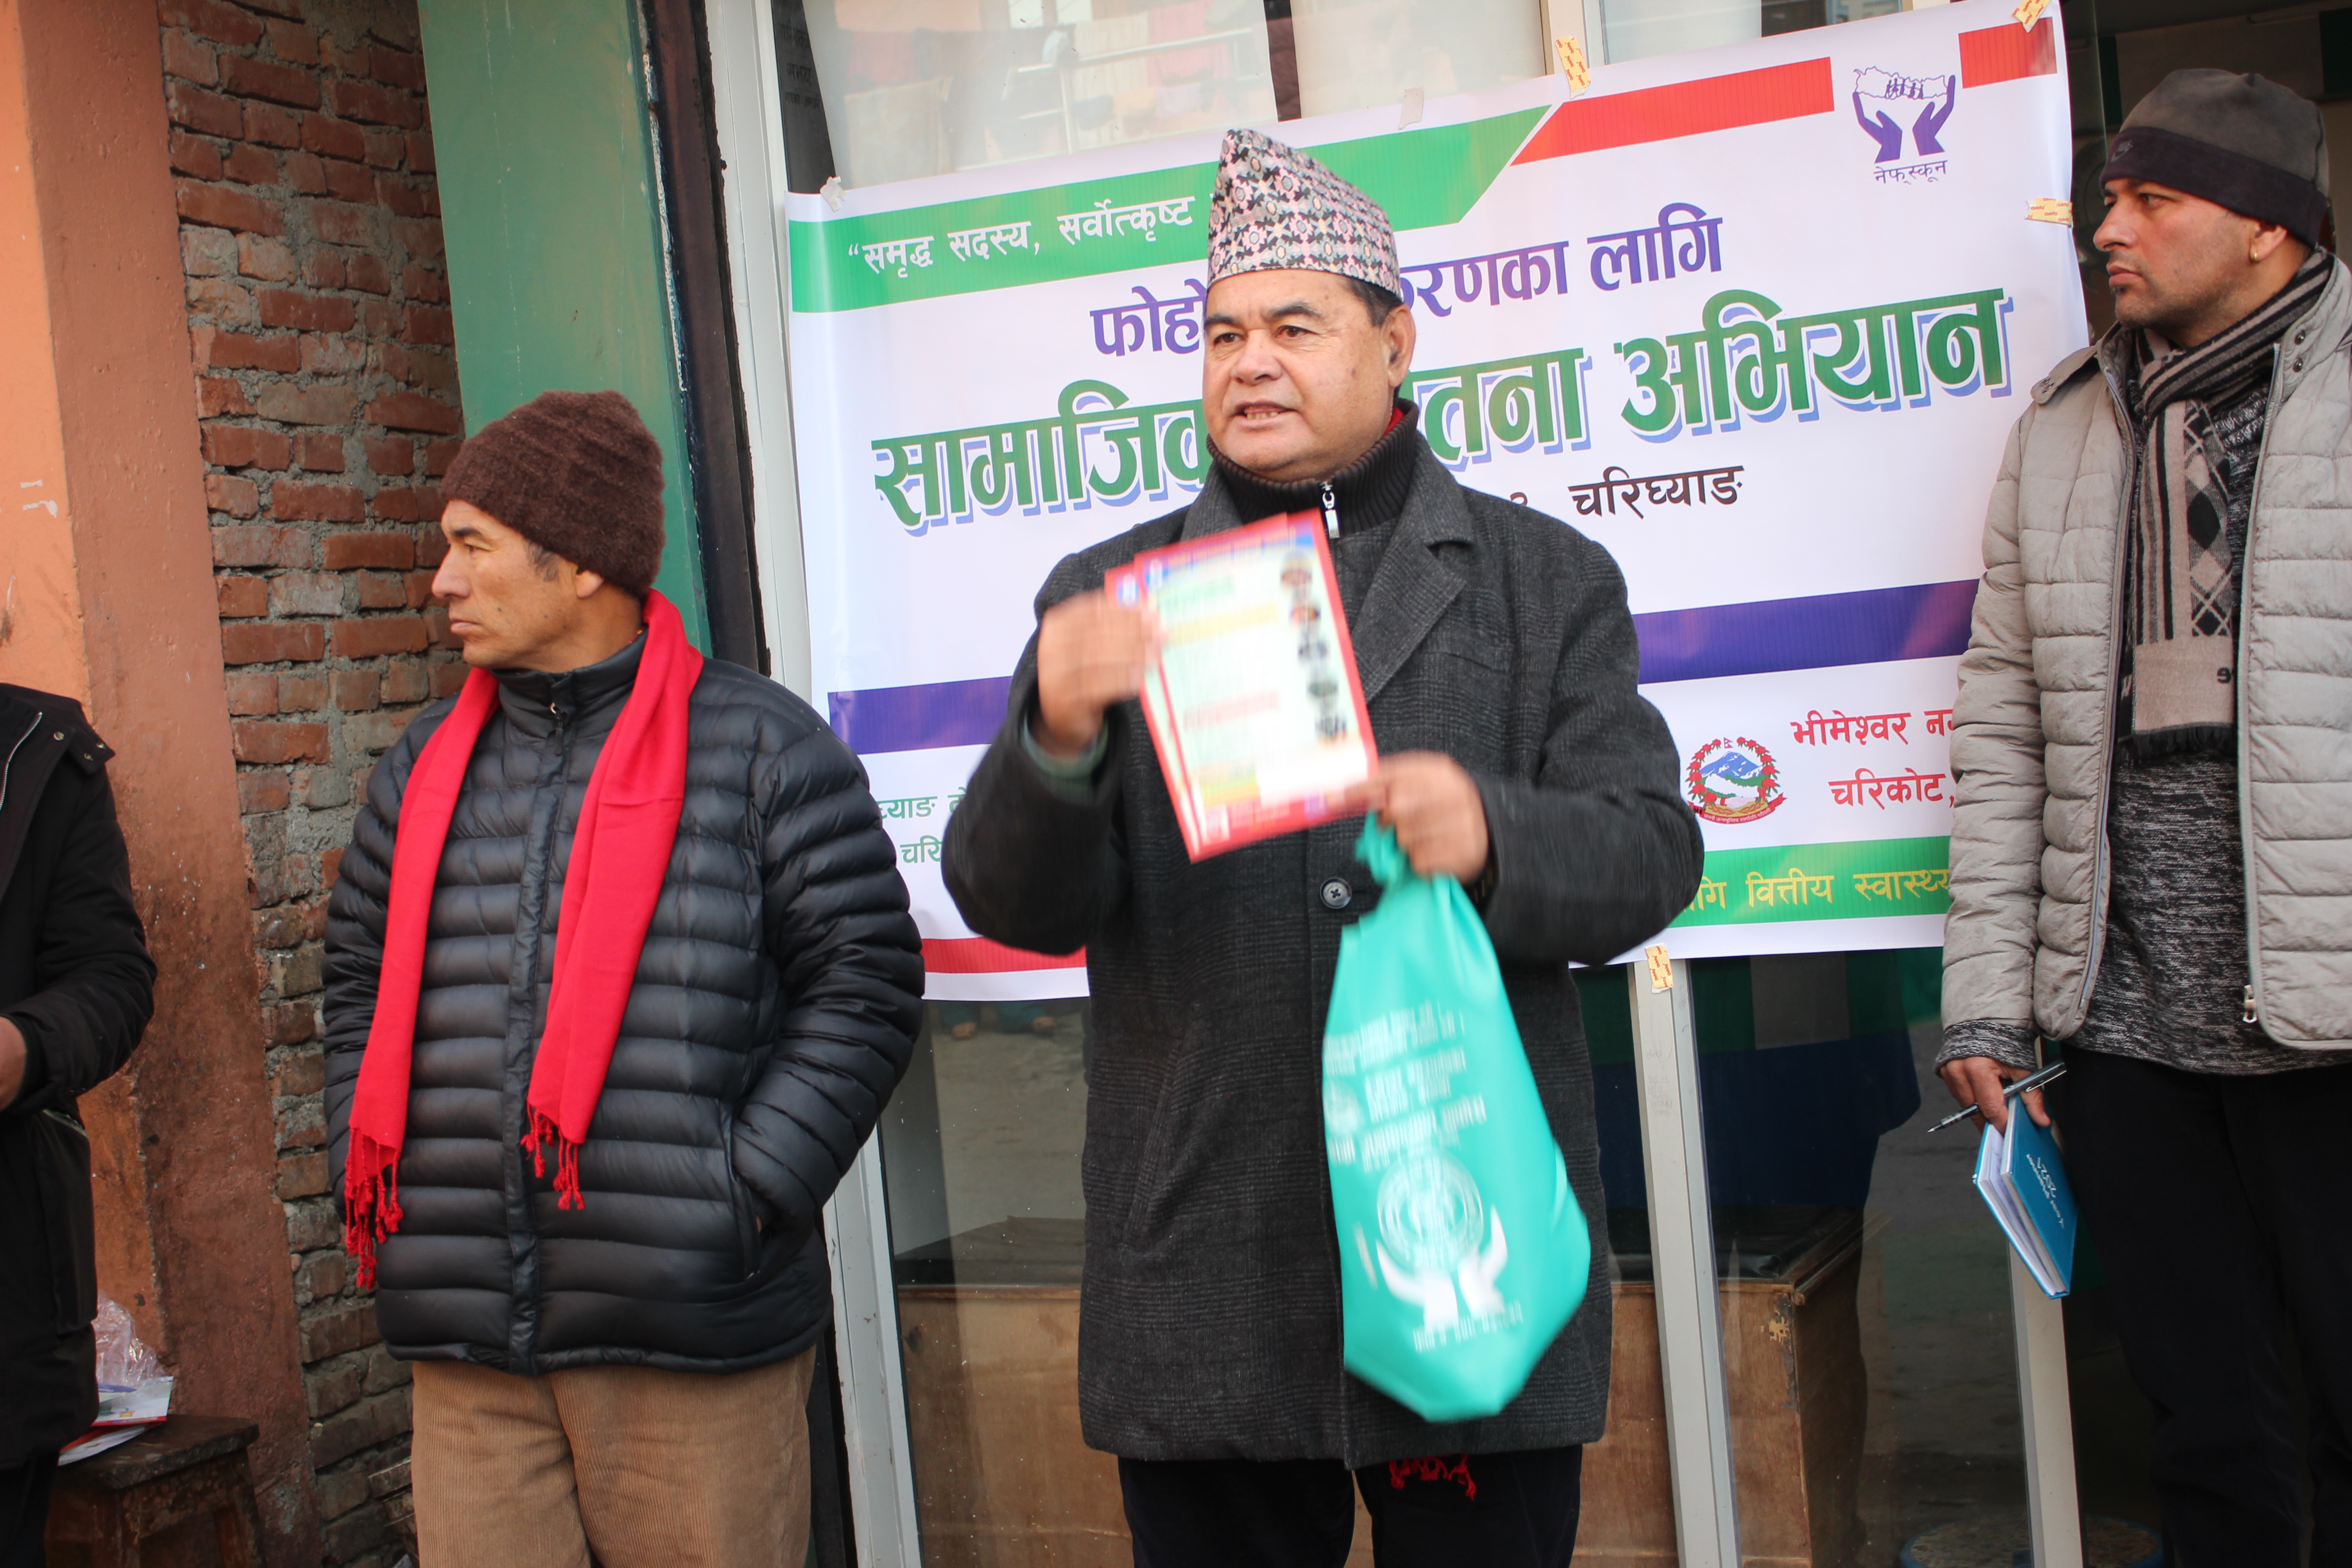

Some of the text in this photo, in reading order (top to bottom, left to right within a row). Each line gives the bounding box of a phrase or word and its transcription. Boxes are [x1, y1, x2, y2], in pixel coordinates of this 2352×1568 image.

[946, 220, 1040, 262] सदस्य,
[1056, 196, 1196, 246] सर्वोत्कृष्ट
[1400, 240, 1569, 318] रणका
[1587, 202, 1723, 291] लागि
[1613, 287, 2014, 444] अभियान
[1790, 710, 1912, 746] भीमेश्वर
[1745, 867, 1835, 908] वित्तीय
